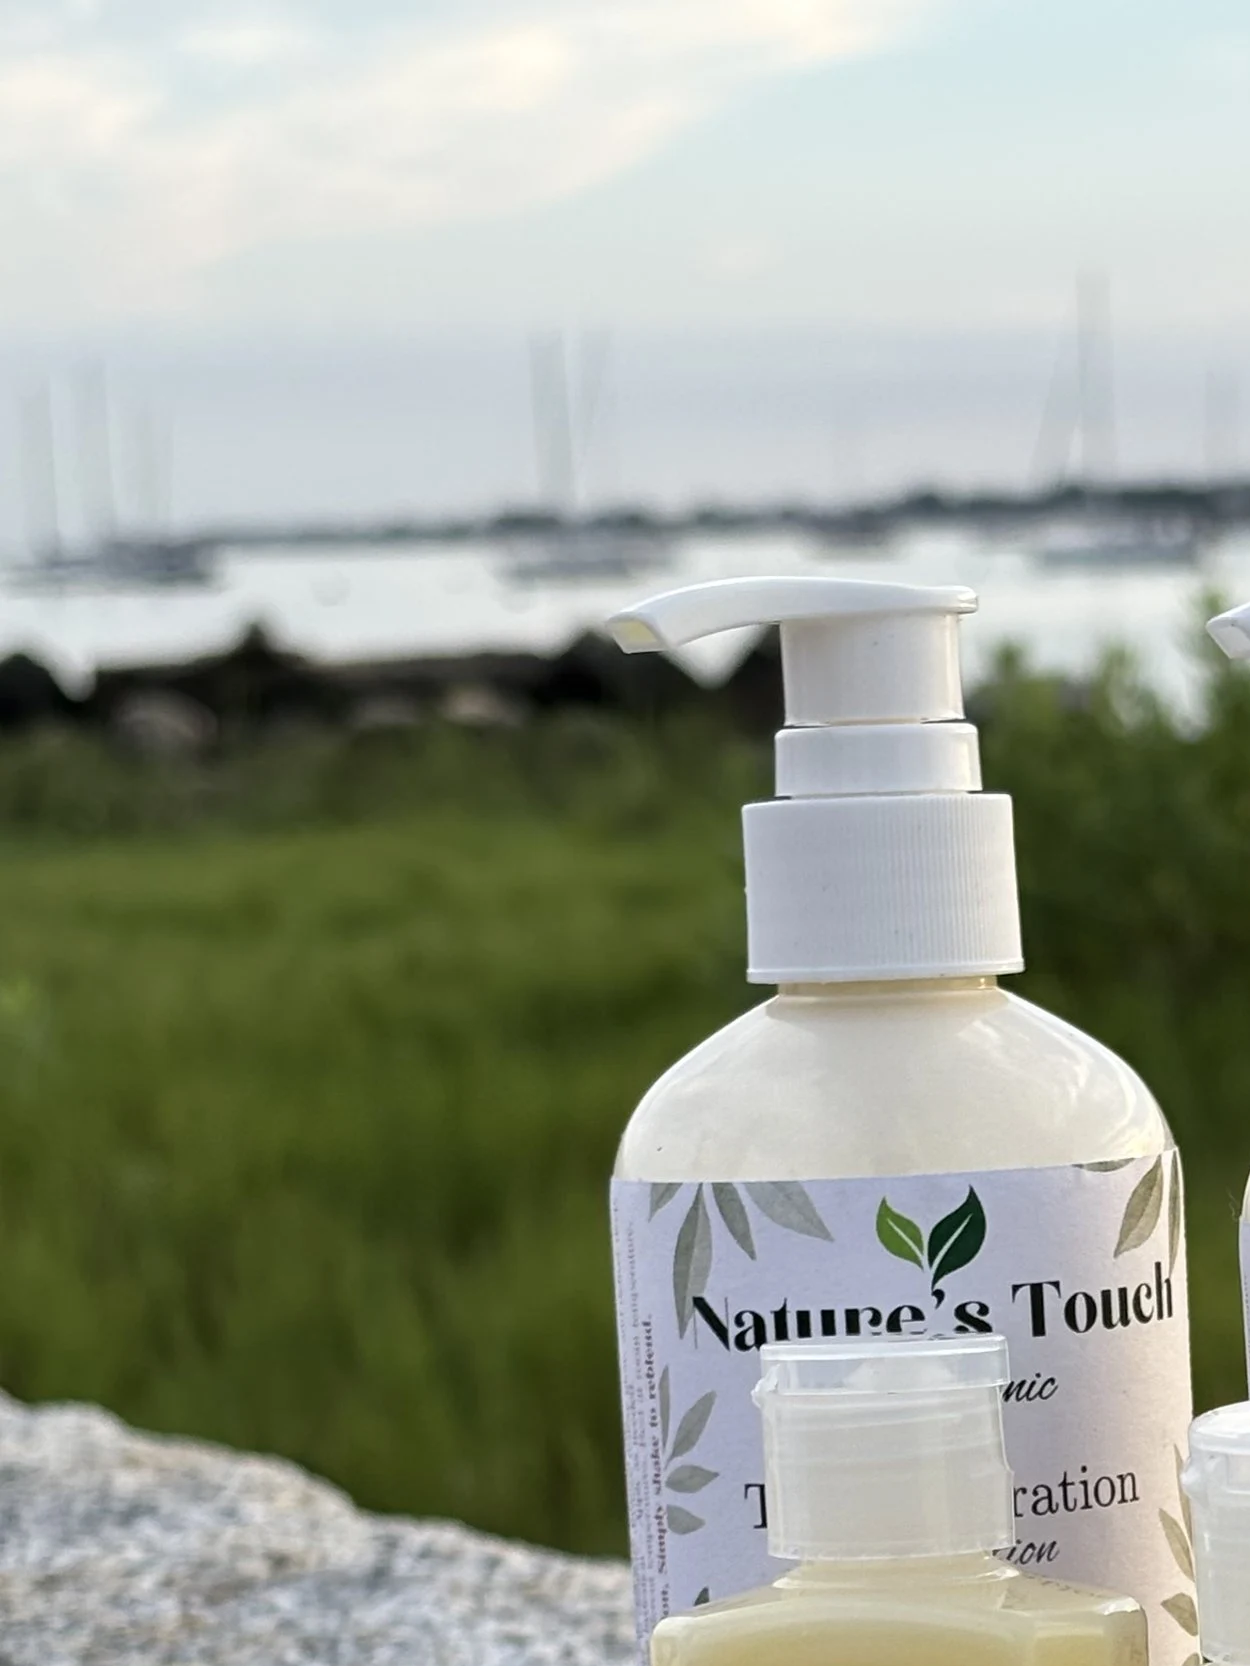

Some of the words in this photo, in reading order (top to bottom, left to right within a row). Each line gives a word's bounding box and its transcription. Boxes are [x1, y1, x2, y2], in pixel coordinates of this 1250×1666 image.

[691, 1287, 993, 1352] Nature's
[1011, 1261, 1174, 1338] Touch
[1013, 1465, 1140, 1518] ration
